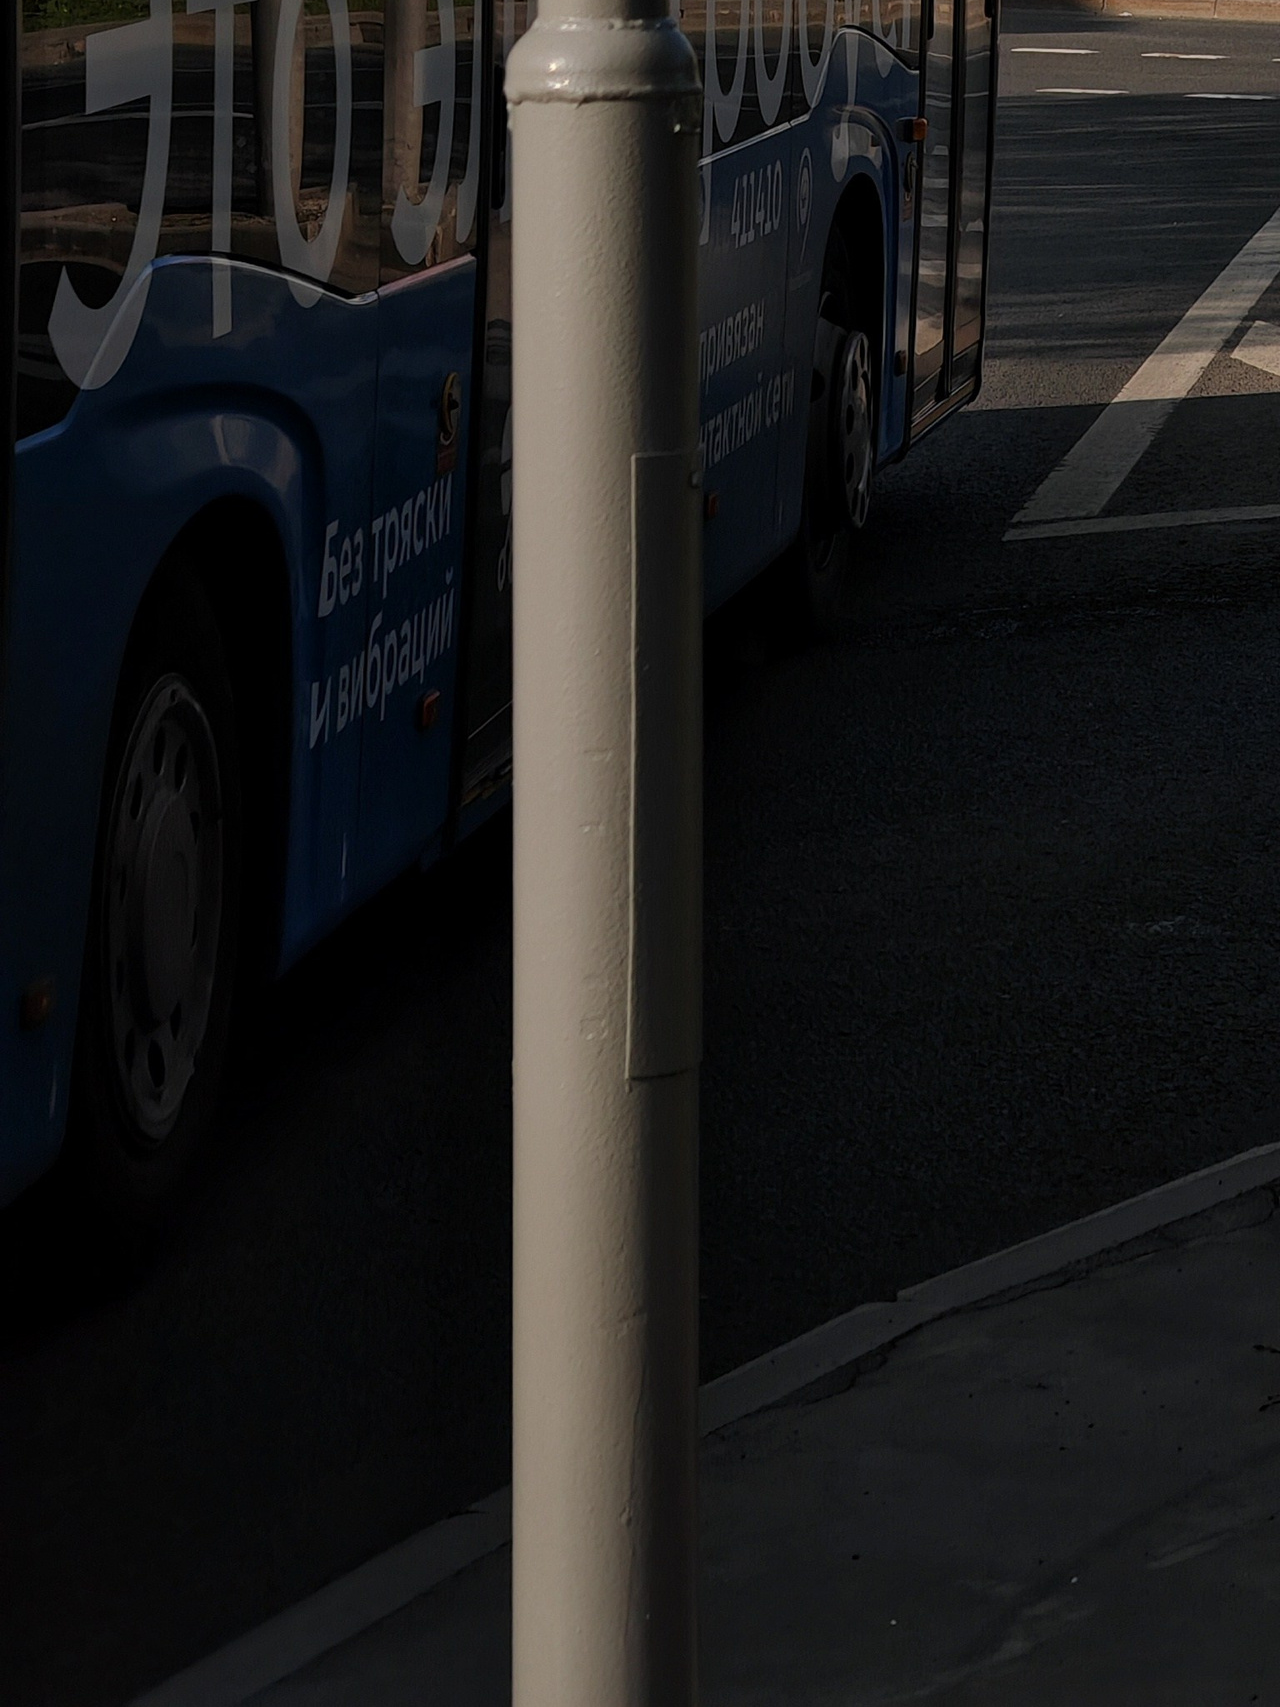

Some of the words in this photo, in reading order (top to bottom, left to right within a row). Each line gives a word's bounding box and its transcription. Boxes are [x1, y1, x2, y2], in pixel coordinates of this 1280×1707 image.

[730, 159, 783, 249] 411410
[699, 298, 765, 395] привязан
[699, 371, 764, 470] нтактной
[764, 364, 796, 429] сети
[317, 519, 365, 618] Без
[370, 472, 453, 599] тряски
[309, 676, 332, 750] и
[336, 566, 455, 737] вибраций
